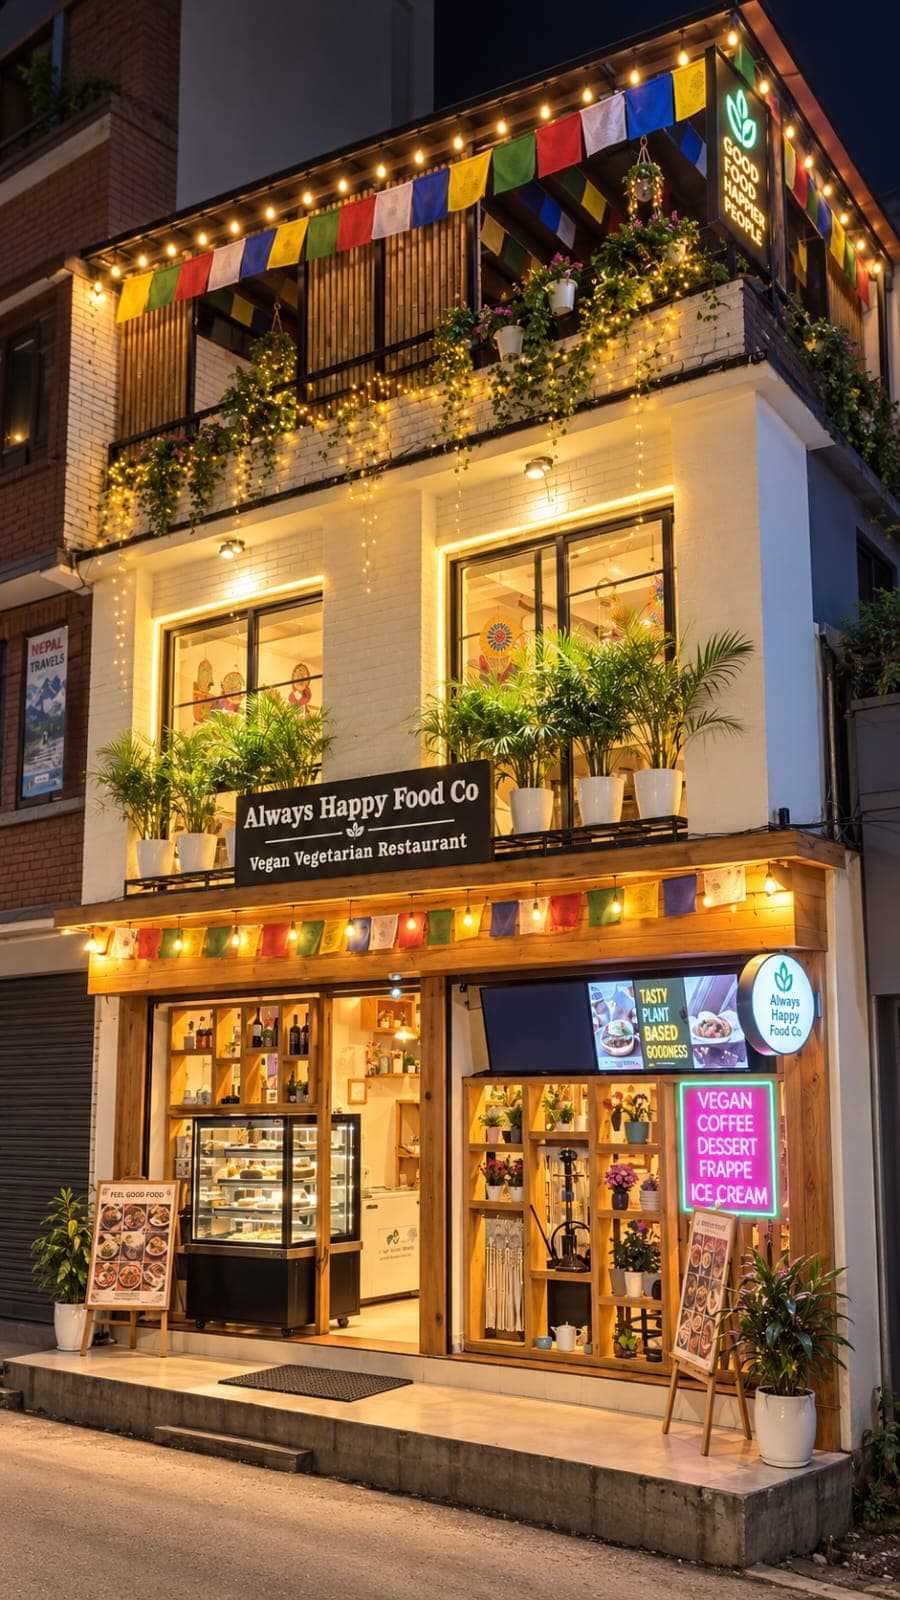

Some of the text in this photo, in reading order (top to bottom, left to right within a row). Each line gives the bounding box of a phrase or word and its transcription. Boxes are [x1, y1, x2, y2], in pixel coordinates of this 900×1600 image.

[723, 136, 759, 183] GOOD
[723, 156, 757, 200] FOOD
[723, 176, 766, 230] HAPPIER
[724, 196, 763, 247] PEOPLE
[31, 637, 64, 657] NEPAL
[30, 653, 65, 673] TRAVELS
[243, 779, 479, 829] Always Happy Food Co
[249, 833, 468, 873] Vegan Vegetarian Restaurant
[639, 987, 668, 1005] TASTY
[770, 994, 801, 1009] Always
[642, 1007, 669, 1023] PLANT
[771, 1009, 800, 1024] Happy
[644, 1024, 679, 1042] BASED
[769, 1025, 802, 1037] Food Co
[646, 1044, 689, 1060] GOODNESS
[697, 1091, 753, 1110] VEGAN
[697, 1114, 754, 1132] COFFEE
[697, 1137, 758, 1156] DESSERT
[699, 1160, 753, 1179] FRAPPE
[691, 1183, 768, 1205] ICE CREAM
